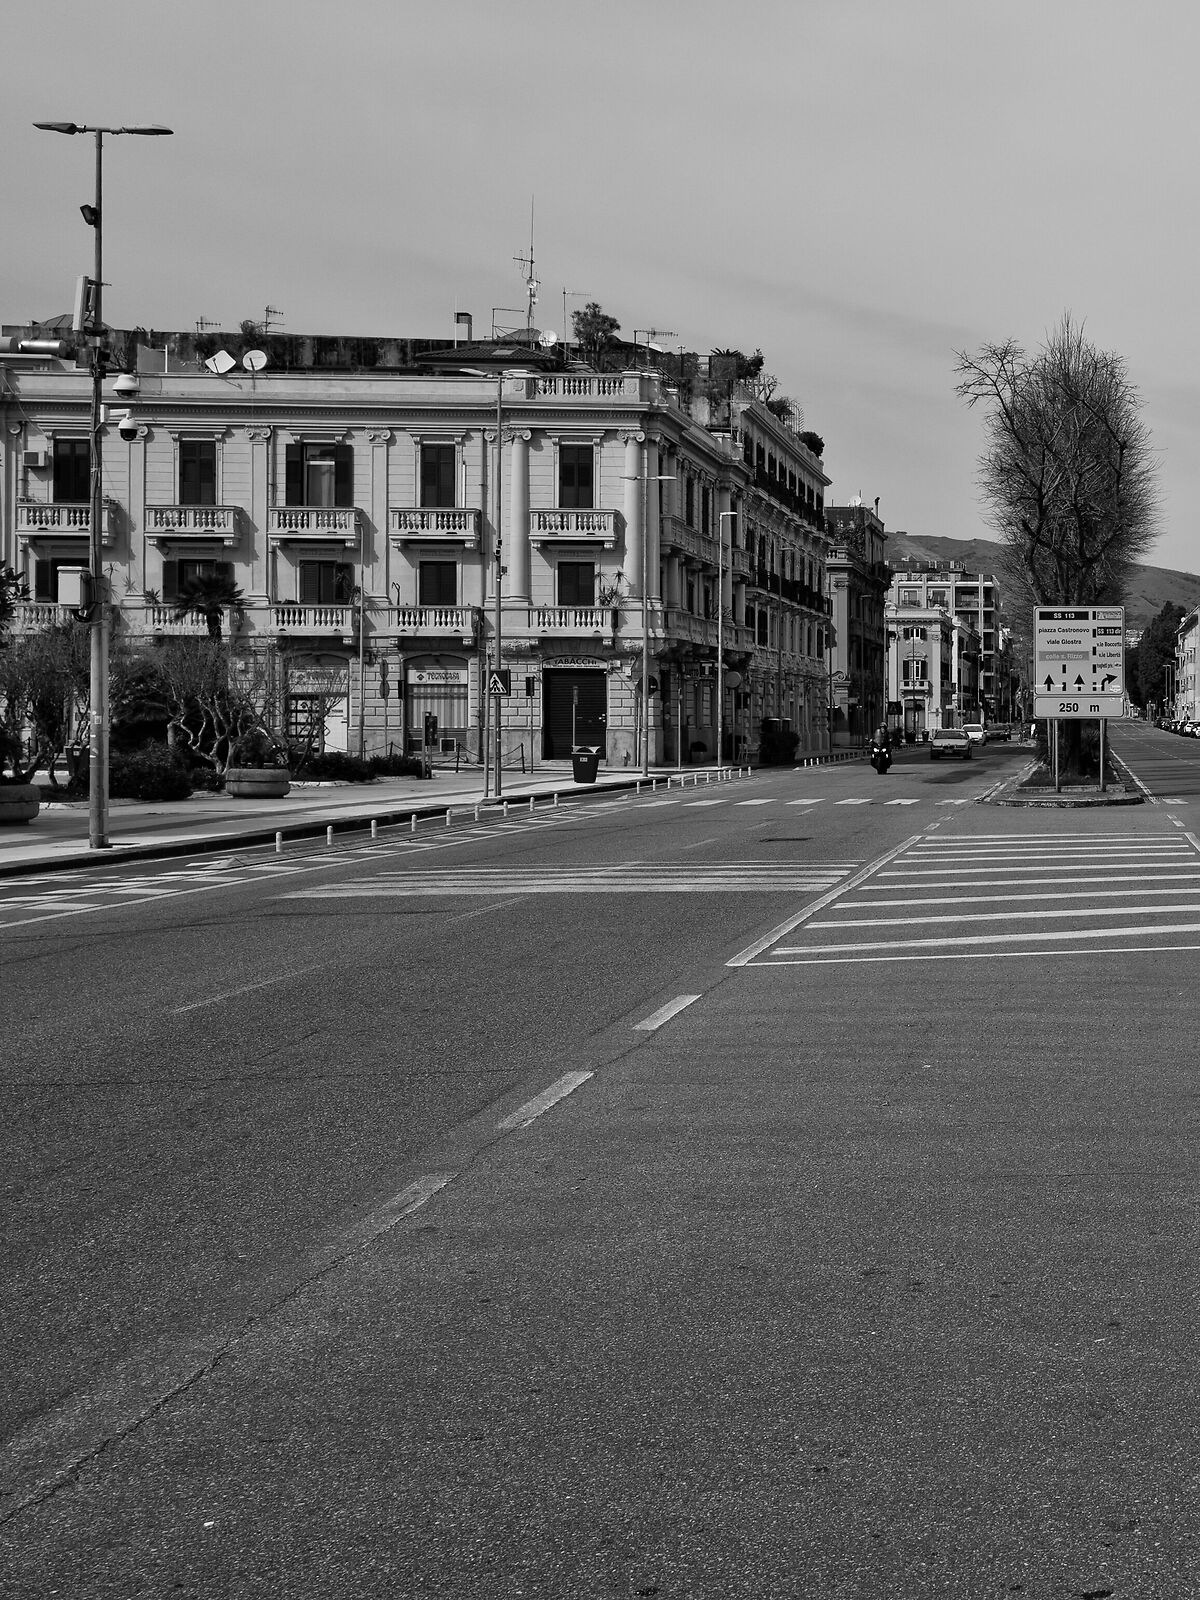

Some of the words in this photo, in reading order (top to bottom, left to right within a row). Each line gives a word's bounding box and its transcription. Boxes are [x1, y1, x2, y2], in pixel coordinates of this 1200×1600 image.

[1038, 627, 1056, 635] piazza
[426, 672, 460, 680] TECNOCASA
[1059, 703, 1079, 713] 250
[1089, 704, 1100, 713] m
